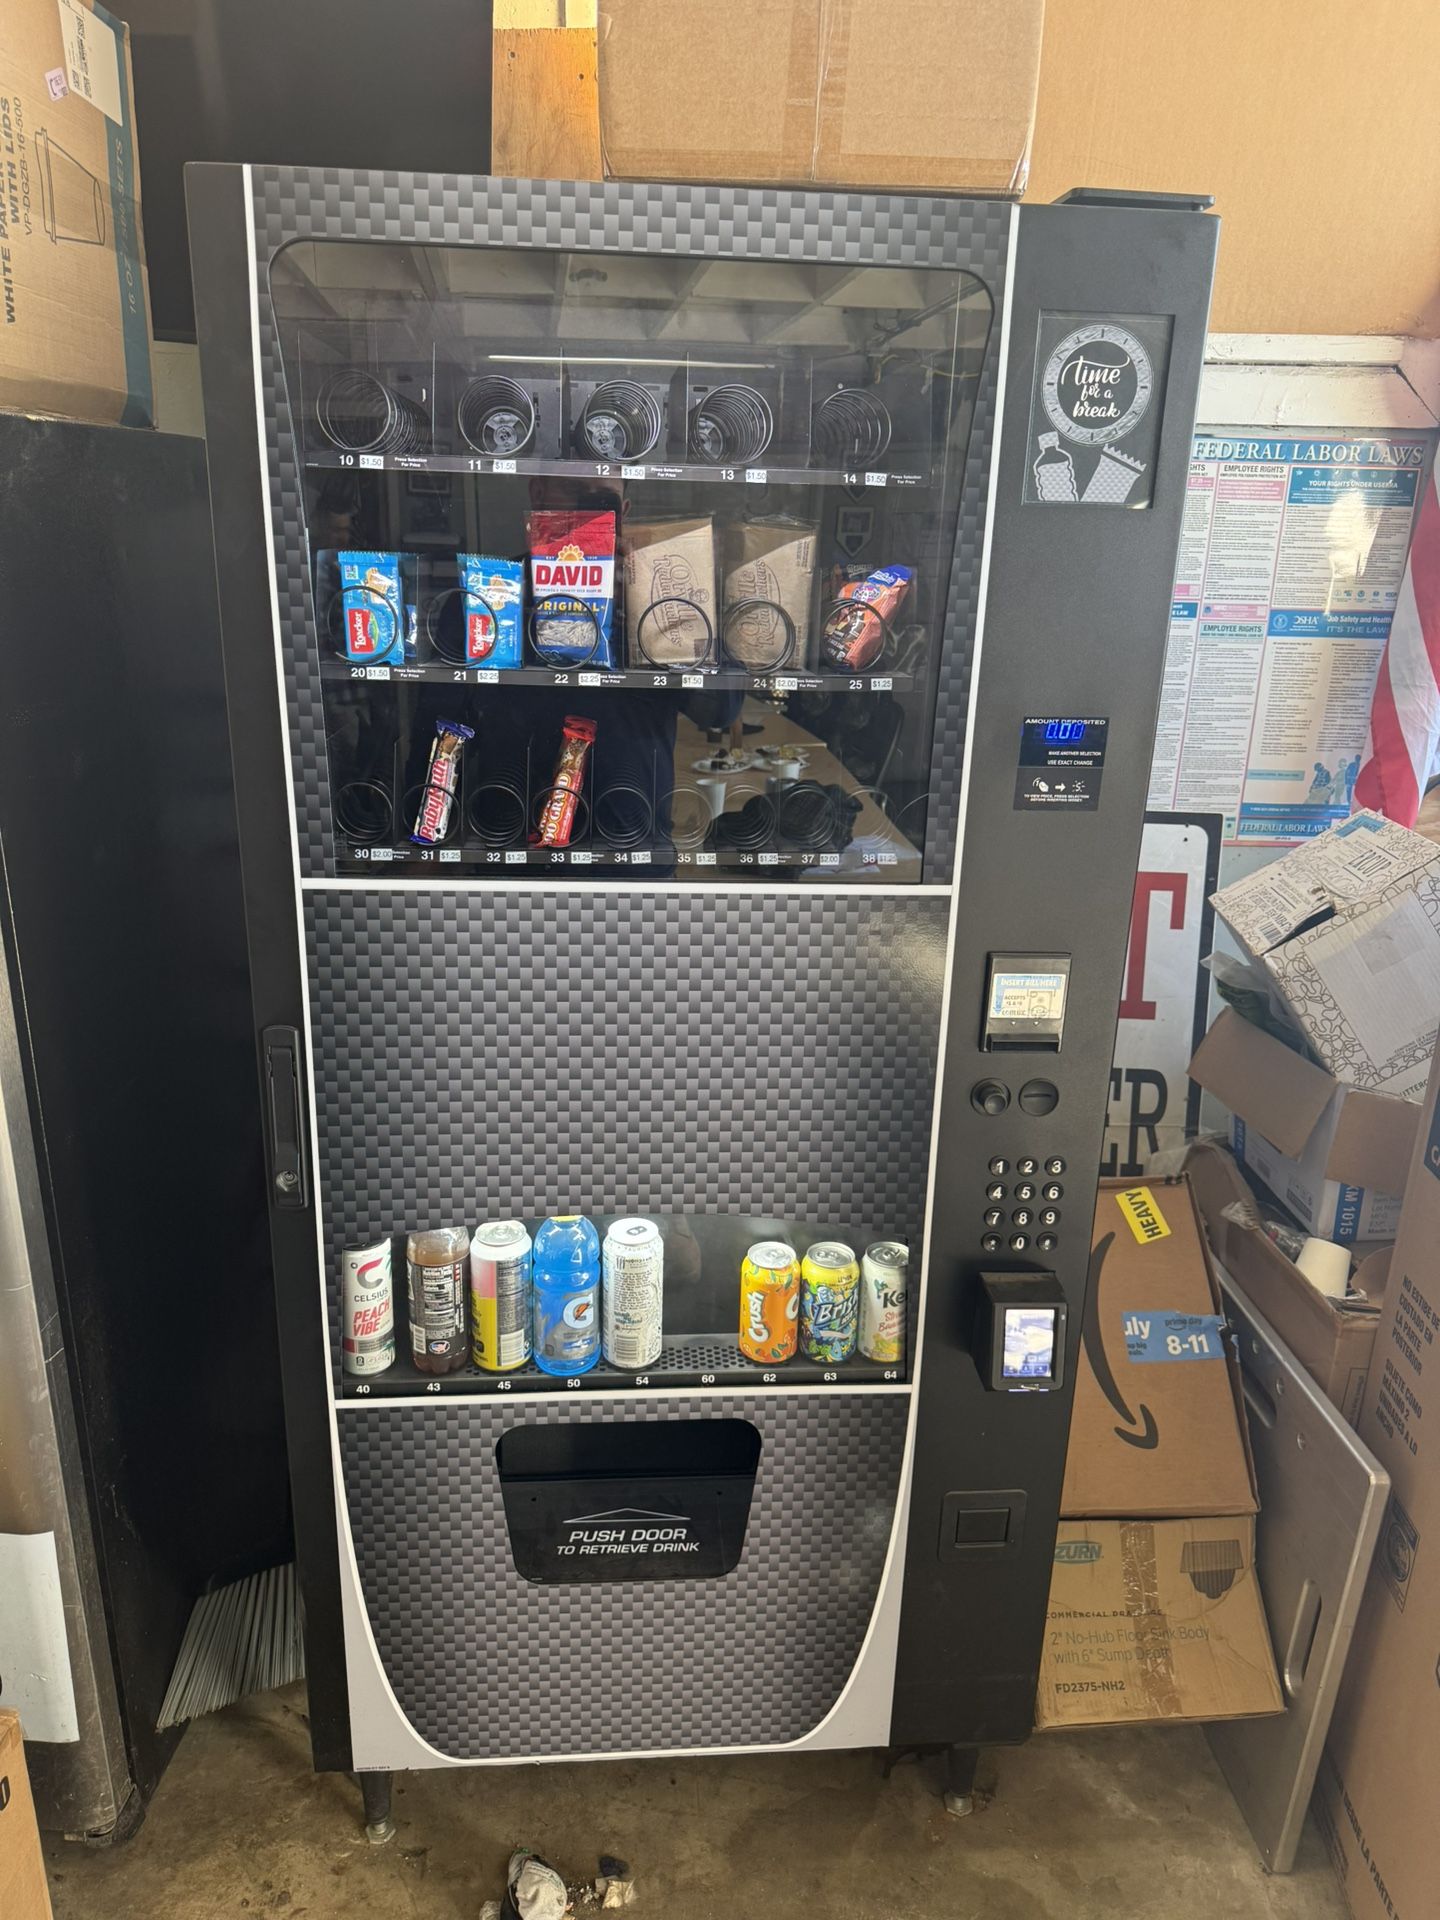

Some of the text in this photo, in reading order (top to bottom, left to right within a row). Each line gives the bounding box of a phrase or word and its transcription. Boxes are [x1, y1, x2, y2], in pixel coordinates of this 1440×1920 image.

[0, 97, 20, 224] WITH LIDS
[2, 246, 16, 324] WHITE
[1081, 382, 1114, 401] for a
[1073, 400, 1121, 418] break
[1192, 440, 1423, 465] FEDERAL LABOR LAWS
[339, 455, 382, 467] 10 $1.50
[468, 460, 516, 472] 11 $1.50
[596, 465, 644, 478] 12 $1.50
[1224, 464, 1285, 474] EMPLOYEE RIGHTS
[721, 470, 766, 481] 13 $1.50
[843, 474, 886, 484] 14 $1.50
[536, 564, 602, 586] DAVID
[1360, 616, 1371, 624] and
[1372, 616, 1392, 624] Health
[354, 610, 363, 650] Loacker
[1203, 624, 1262, 634] EMPLOYEE RIGHTS
[1346, 626, 1364, 634] THE
[351, 668, 388, 678] 20 $1.50
[454, 671, 499, 682] 21 $2.25
[554, 674, 599, 683] 22 $2.25
[654, 676, 702, 686] 23 $1.50
[754, 679, 796, 688] 24 $2.00
[850, 680, 891, 689] 25 $1.25
[1046, 724, 1084, 739] 0.00
[1240, 824, 1276, 832] FEDERAL
[1278, 824, 1306, 832] LABOR
[355, 849, 392, 859] 30 $2.00
[421, 851, 460, 861] 31 $1.25
[487, 853, 526, 862] 32 $1.25
[551, 853, 591, 862] 33 $1.25
[614, 853, 650, 863] 34 $1.25
[678, 854, 716, 864] 35 $1.25
[740, 854, 778, 864] 36 $1.25
[801, 854, 814, 864] 37
[862, 854, 875, 863] 38
[997, 1161, 1061, 1173] 1 2 3
[993, 1186, 1059, 1199] 4 5 6
[991, 1212, 1054, 1224] 7 8 9
[1126, 1190, 1163, 1239] HEAVY
[1339, 1206, 1355, 1236] 1015
[1016, 1237, 1024, 1249] 0
[354, 1288, 388, 1302] CELSIUS
[354, 1298, 391, 1324] PEACH
[748, 1292, 769, 1342] Crush
[353, 1319, 380, 1336] VIBE
[1166, 1334, 1210, 1355] 8-11
[702, 1374, 715, 1384] 60
[763, 1373, 776, 1382] 62
[824, 1372, 837, 1381] 63
[884, 1370, 897, 1379] 64
[498, 1381, 511, 1390] 45
[567, 1379, 580, 1388] 50
[636, 1377, 649, 1385] 54
[356, 1385, 370, 1393] 40
[427, 1383, 441, 1392] 43
[569, 1528, 688, 1543] PUSH DOOR
[557, 1542, 700, 1555] TO RETRIEVE DRINK
[1055, 1544, 1102, 1560] ZURN
[1066, 1630, 1114, 1644] No-Hub
[1117, 1628, 1148, 1642] Floor
[1150, 1627, 1176, 1642] Sink
[1179, 1626, 1209, 1641] Body
[1054, 1652, 1079, 1664] with
[1096, 1648, 1133, 1664] Sump
[1055, 1680, 1126, 1694] FD2375-NH2
